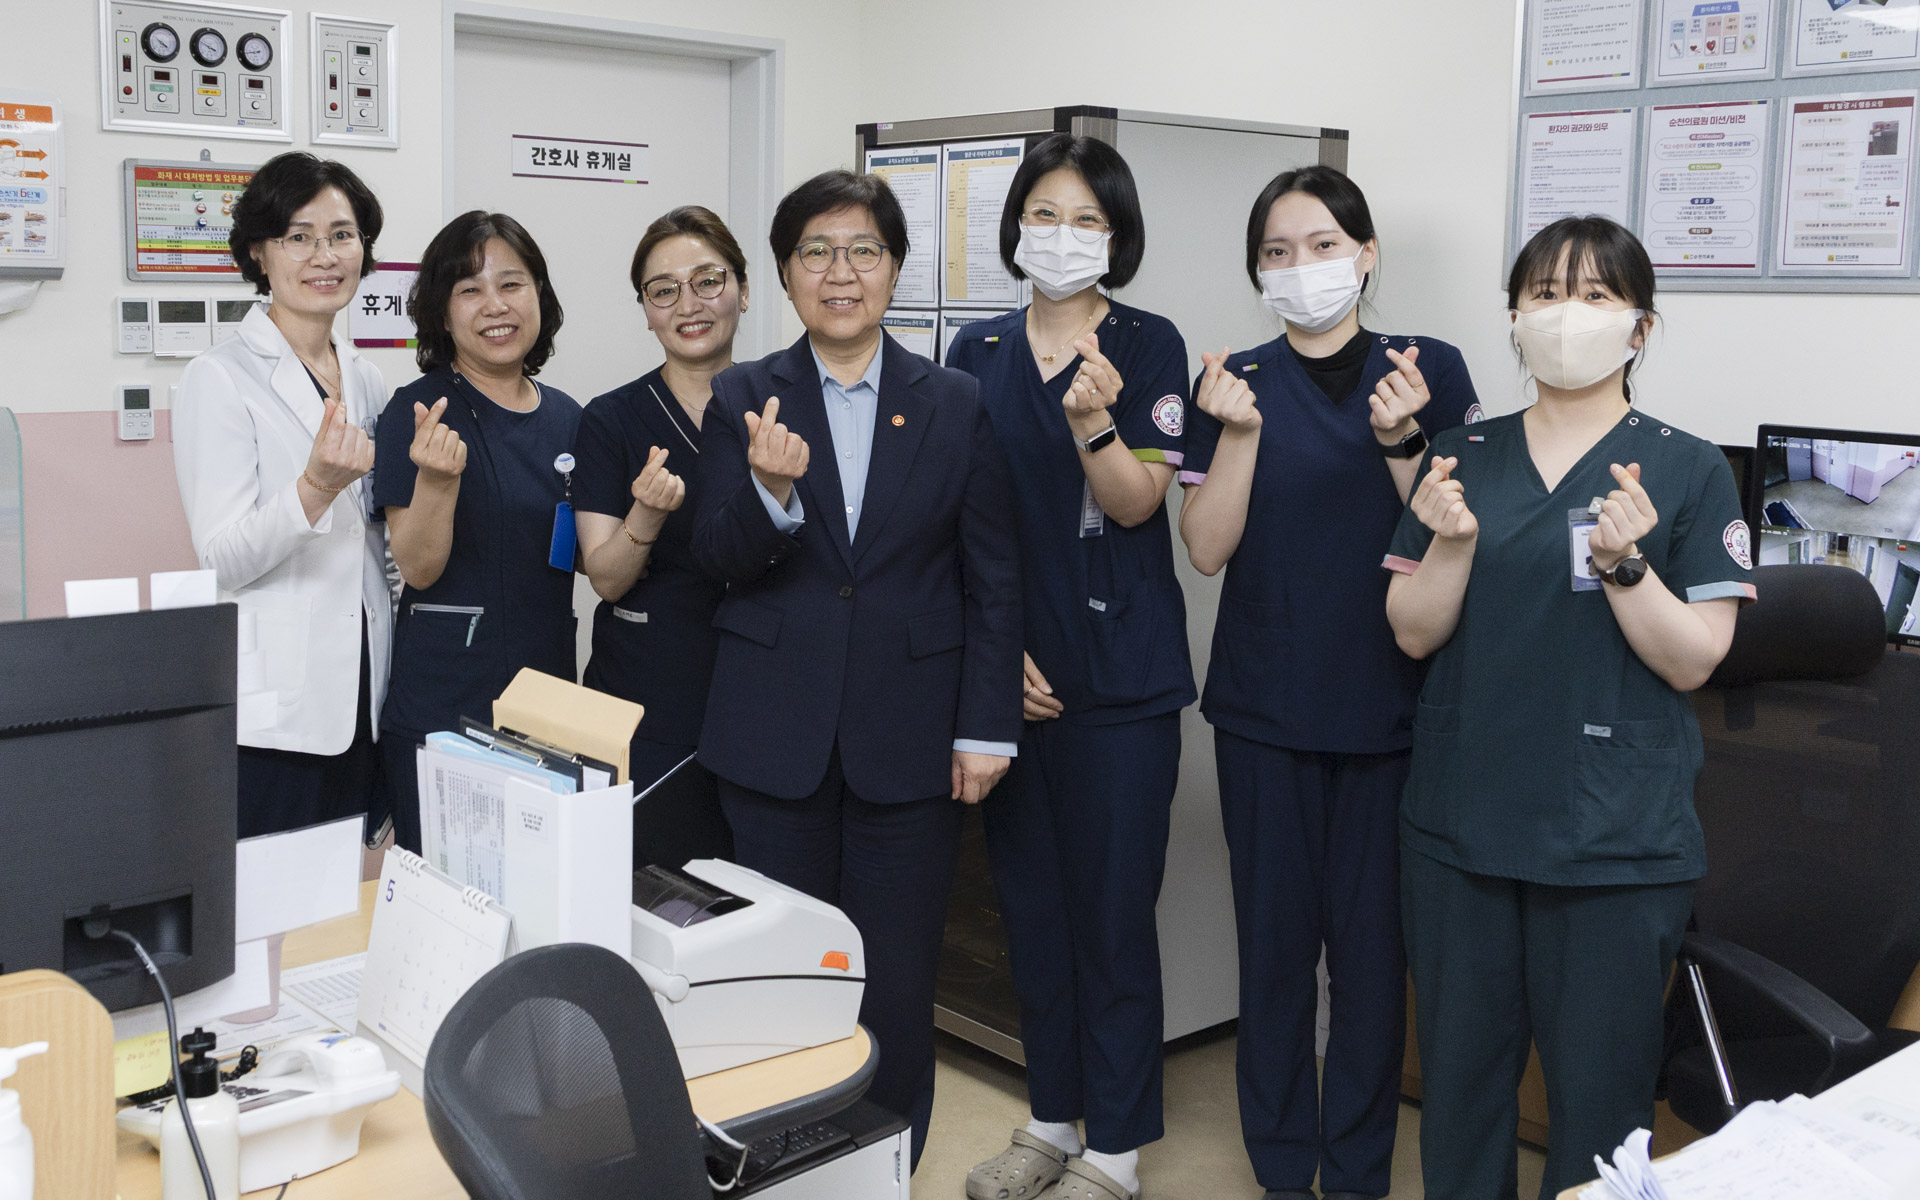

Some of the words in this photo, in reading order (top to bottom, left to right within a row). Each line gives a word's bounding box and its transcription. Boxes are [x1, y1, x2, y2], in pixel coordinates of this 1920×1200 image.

[1548, 125, 1569, 133] 환자의
[1571, 124, 1592, 132] 권리와
[1593, 122, 1608, 131] 의무
[1669, 116, 1708, 127] 순천의료원
[1710, 114, 1746, 125] 미션/비전
[531, 147, 579, 168] 간호사
[586, 151, 631, 171] 휴게실
[157, 171, 172, 180] 화재
[183, 173, 213, 181] 대처방법
[362, 294, 402, 316] 휴게
[386, 879, 395, 902] 5
